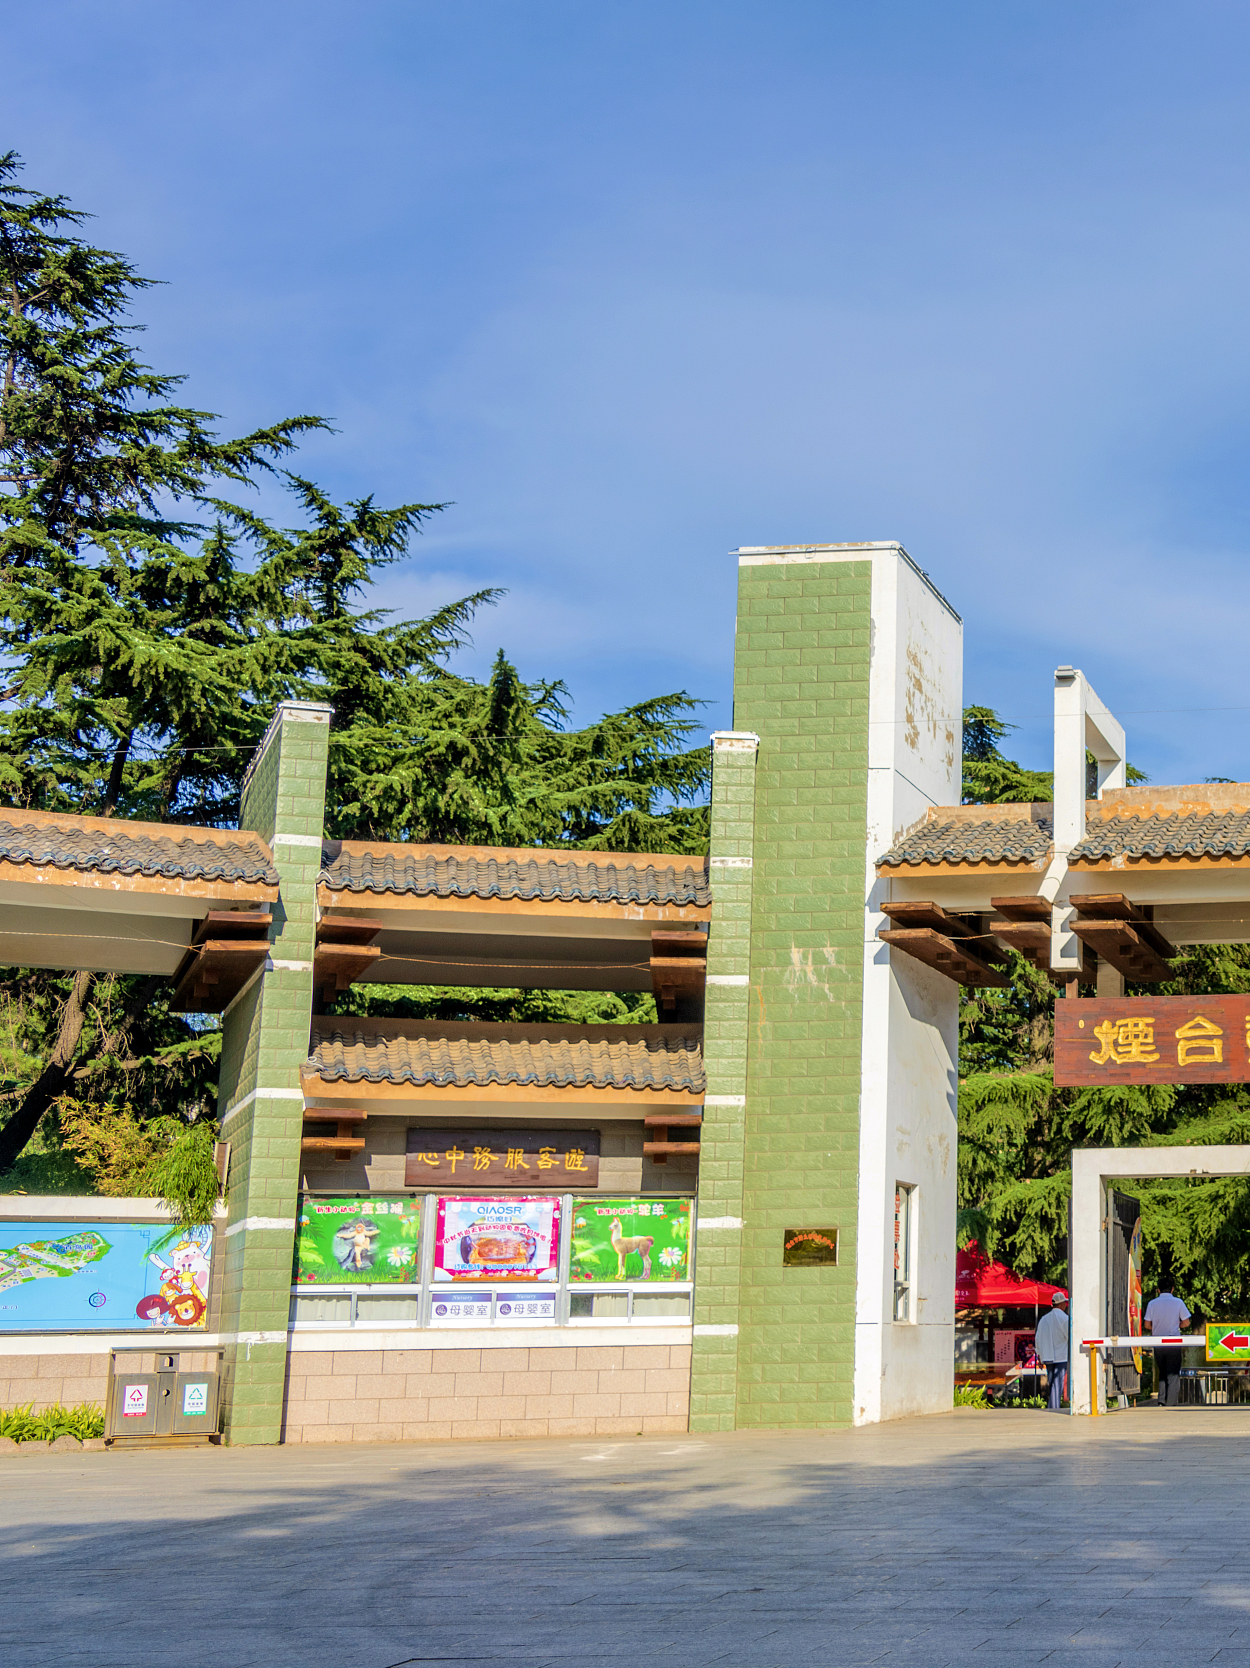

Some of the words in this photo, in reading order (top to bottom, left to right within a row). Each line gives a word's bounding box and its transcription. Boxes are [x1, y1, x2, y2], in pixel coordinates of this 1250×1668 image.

[477, 1206, 522, 1215] QIAOSR
[450, 1304, 488, 1316] 母婴室
[514, 1303, 551, 1315] 母婴室
